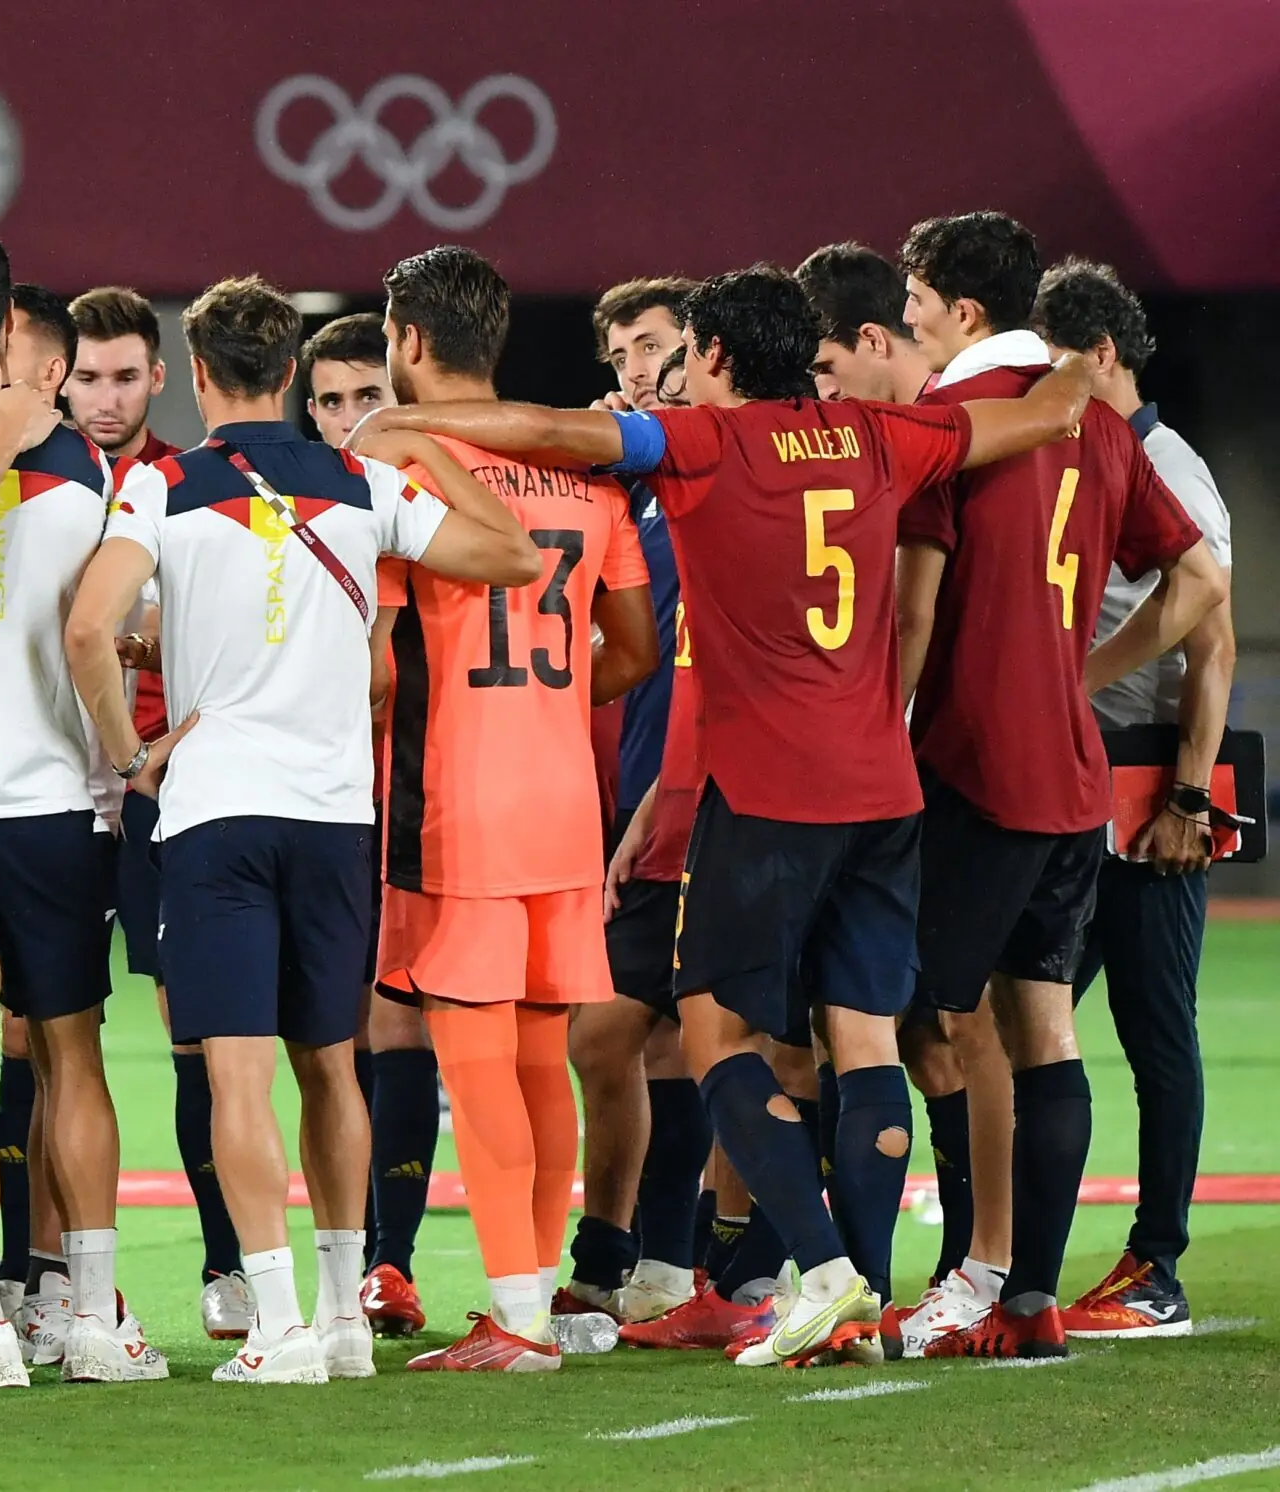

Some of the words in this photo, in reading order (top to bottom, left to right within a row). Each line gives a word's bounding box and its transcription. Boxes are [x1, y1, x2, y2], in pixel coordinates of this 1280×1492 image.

[771, 426, 860, 462] VALLEJO
[340, 574, 361, 601] TOKYO
[468, 529, 584, 689] 13
[803, 489, 855, 650] 5
[1046, 468, 1080, 629] 4
